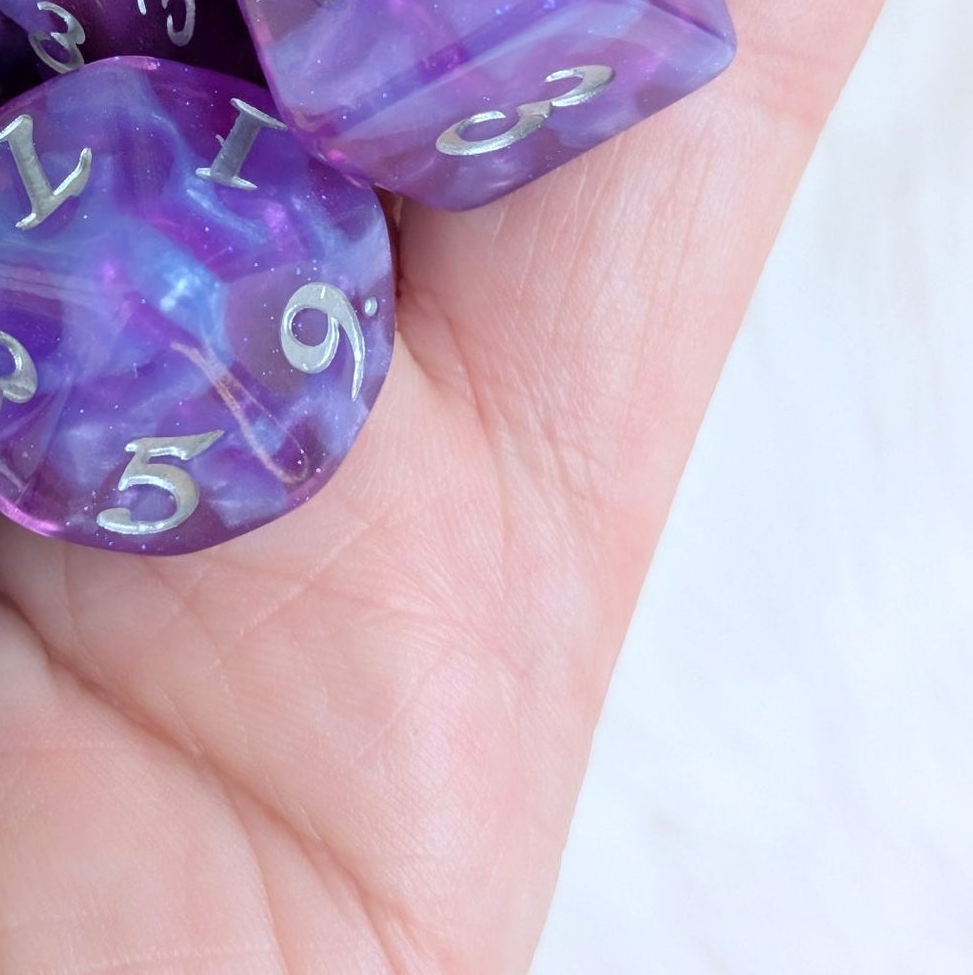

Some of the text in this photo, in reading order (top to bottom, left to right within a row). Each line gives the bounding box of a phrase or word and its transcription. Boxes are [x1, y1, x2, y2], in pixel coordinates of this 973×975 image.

[28, 0, 87, 75] 3
[195, 97, 288, 191] 1
[434, 64, 617, 157] 3
[96, 429, 227, 536] 5
